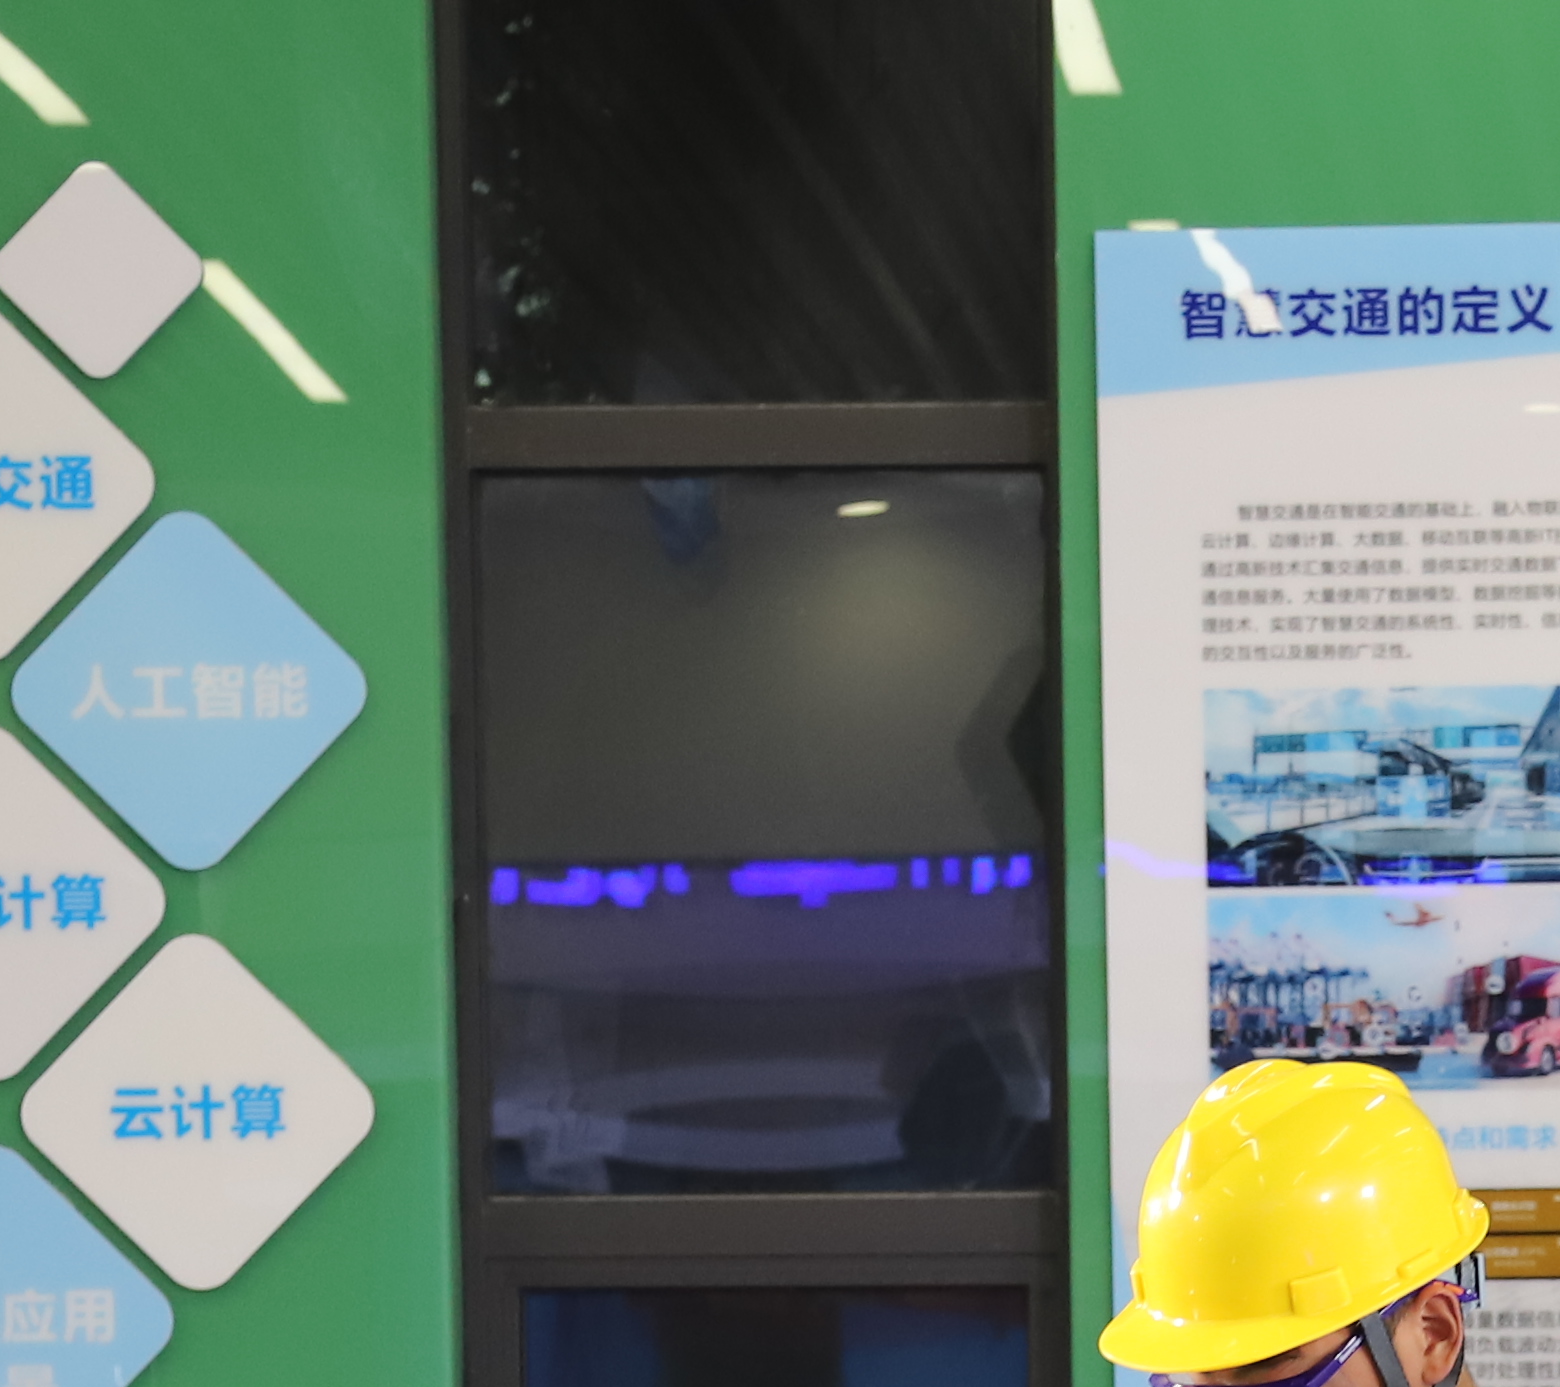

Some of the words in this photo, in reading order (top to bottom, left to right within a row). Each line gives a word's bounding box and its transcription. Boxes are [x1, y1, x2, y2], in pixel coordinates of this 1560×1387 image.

[71, 663, 309, 720] 人工智能
[110, 1084, 286, 1140] 云计算
